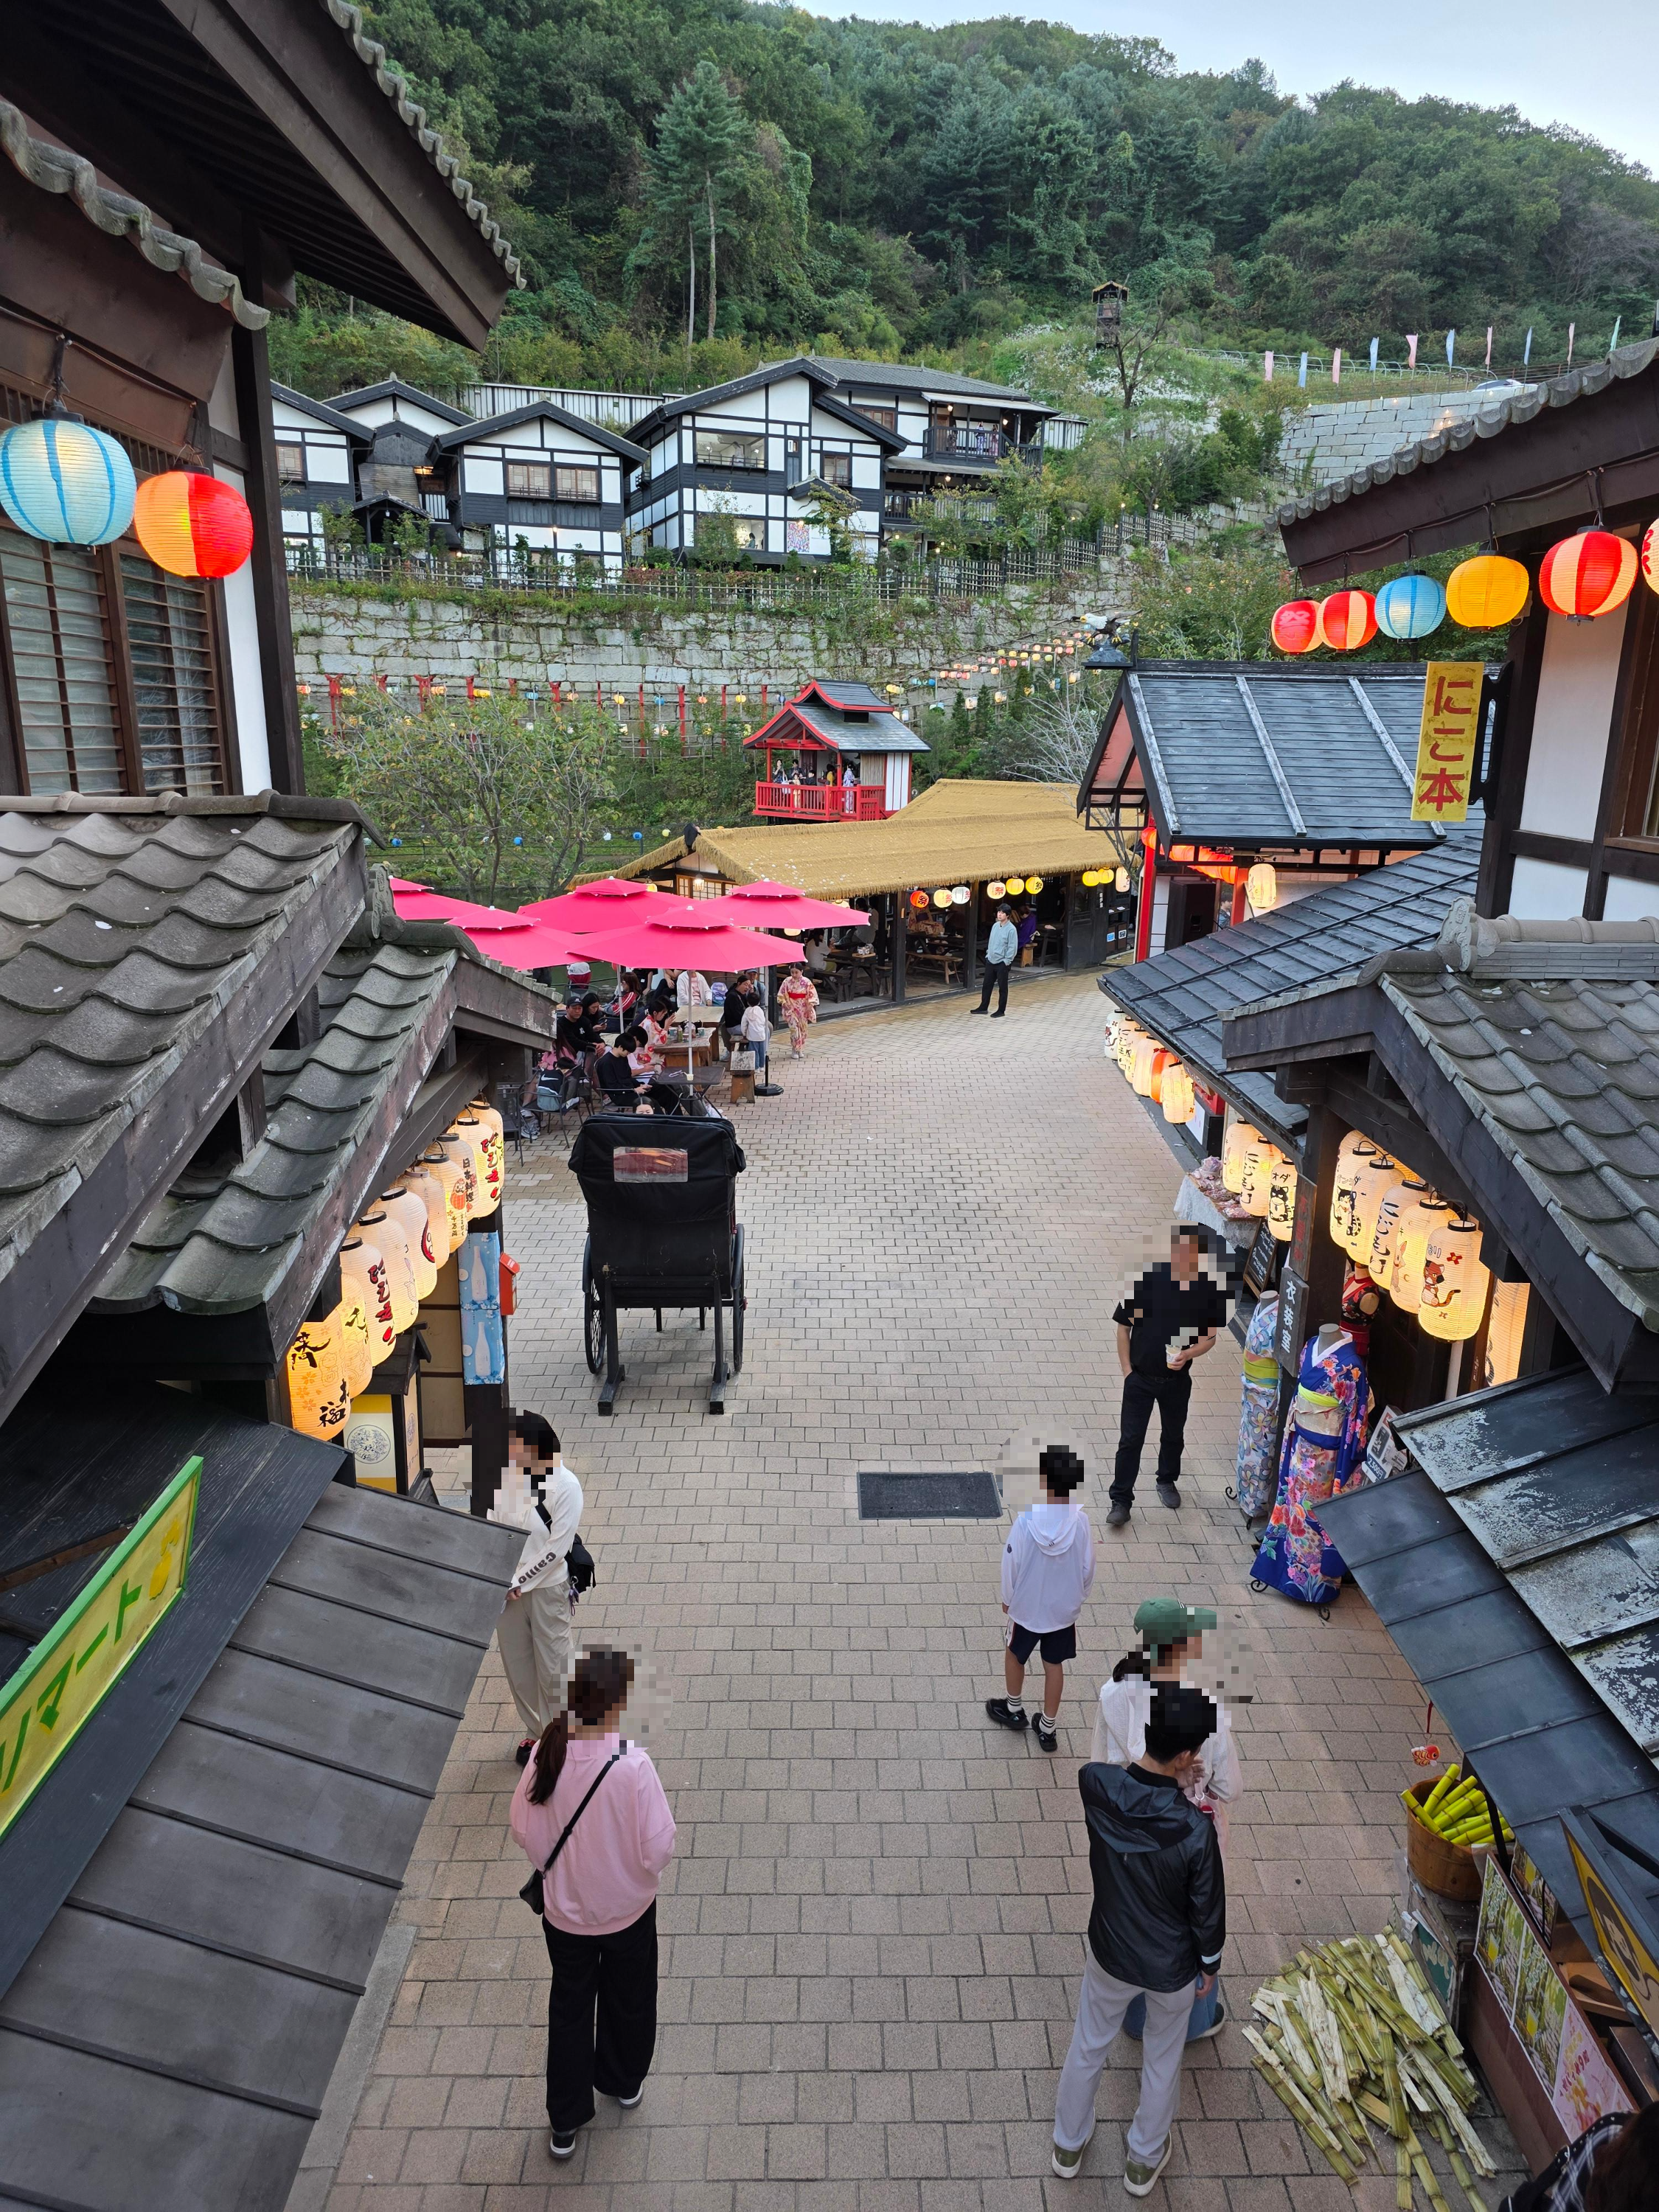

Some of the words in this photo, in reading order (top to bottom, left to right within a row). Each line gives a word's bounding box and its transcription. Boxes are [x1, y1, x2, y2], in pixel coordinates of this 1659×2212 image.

[1418, 675, 1474, 813] にこ本
[462, 1157, 475, 1203] 日本料理
[1272, 1171, 1291, 1183] オダ
